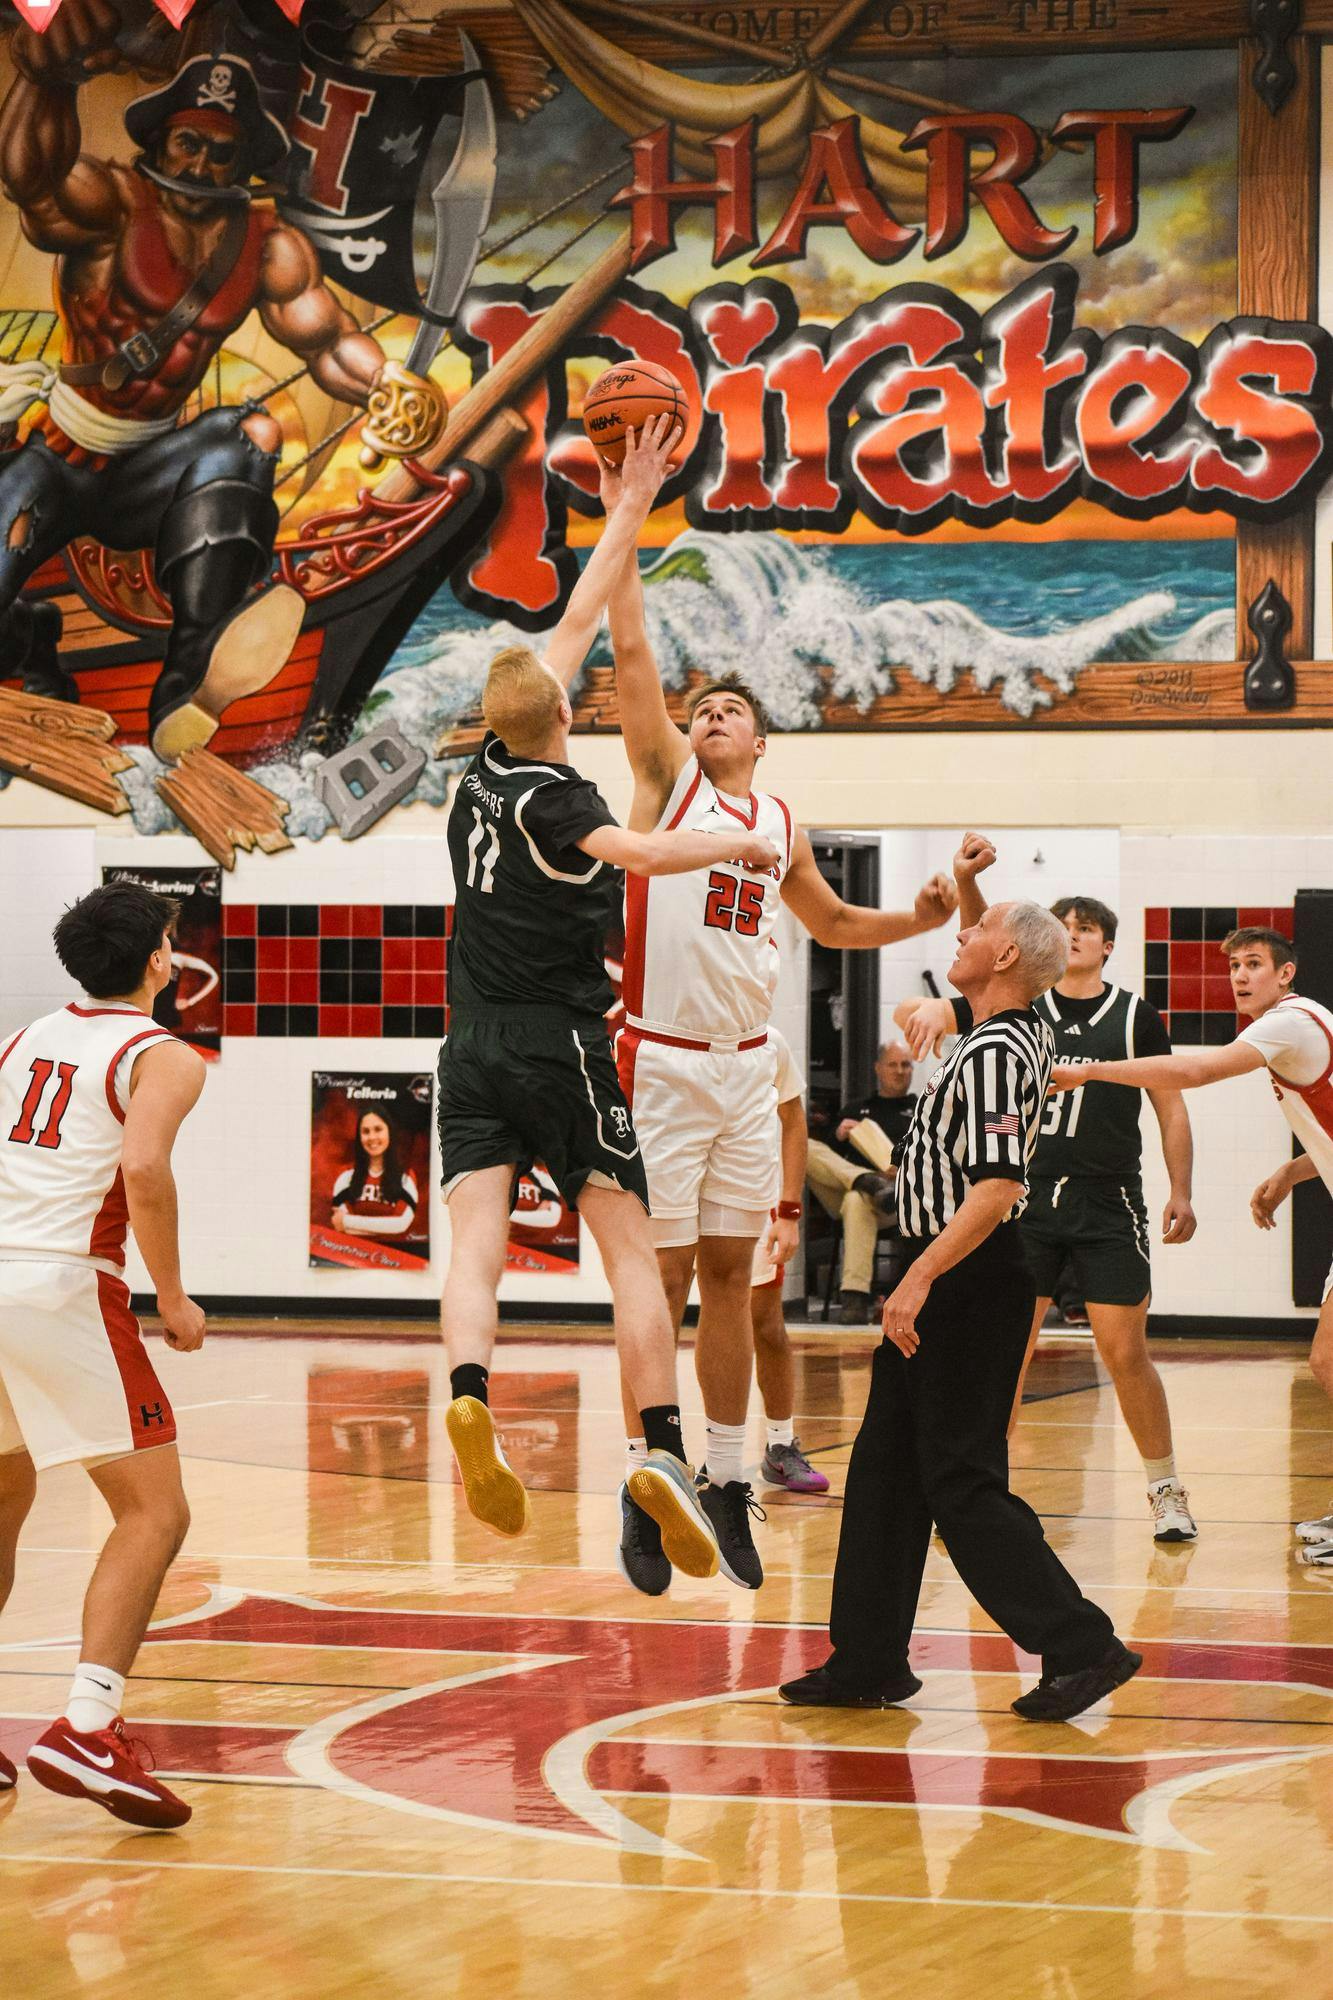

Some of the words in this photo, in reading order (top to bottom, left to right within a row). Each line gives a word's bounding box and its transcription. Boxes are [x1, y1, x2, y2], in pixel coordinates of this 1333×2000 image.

[883, 4, 946, 40] OF
[1007, 0, 1118, 33] THE
[606, 105, 1196, 269] HART
[458, 266, 1331, 632] Pirates
[466, 806, 501, 894] 11
[704, 870, 765, 937] 25
[8, 1057, 80, 1150] 11
[346, 1086, 398, 1100] Telleria
